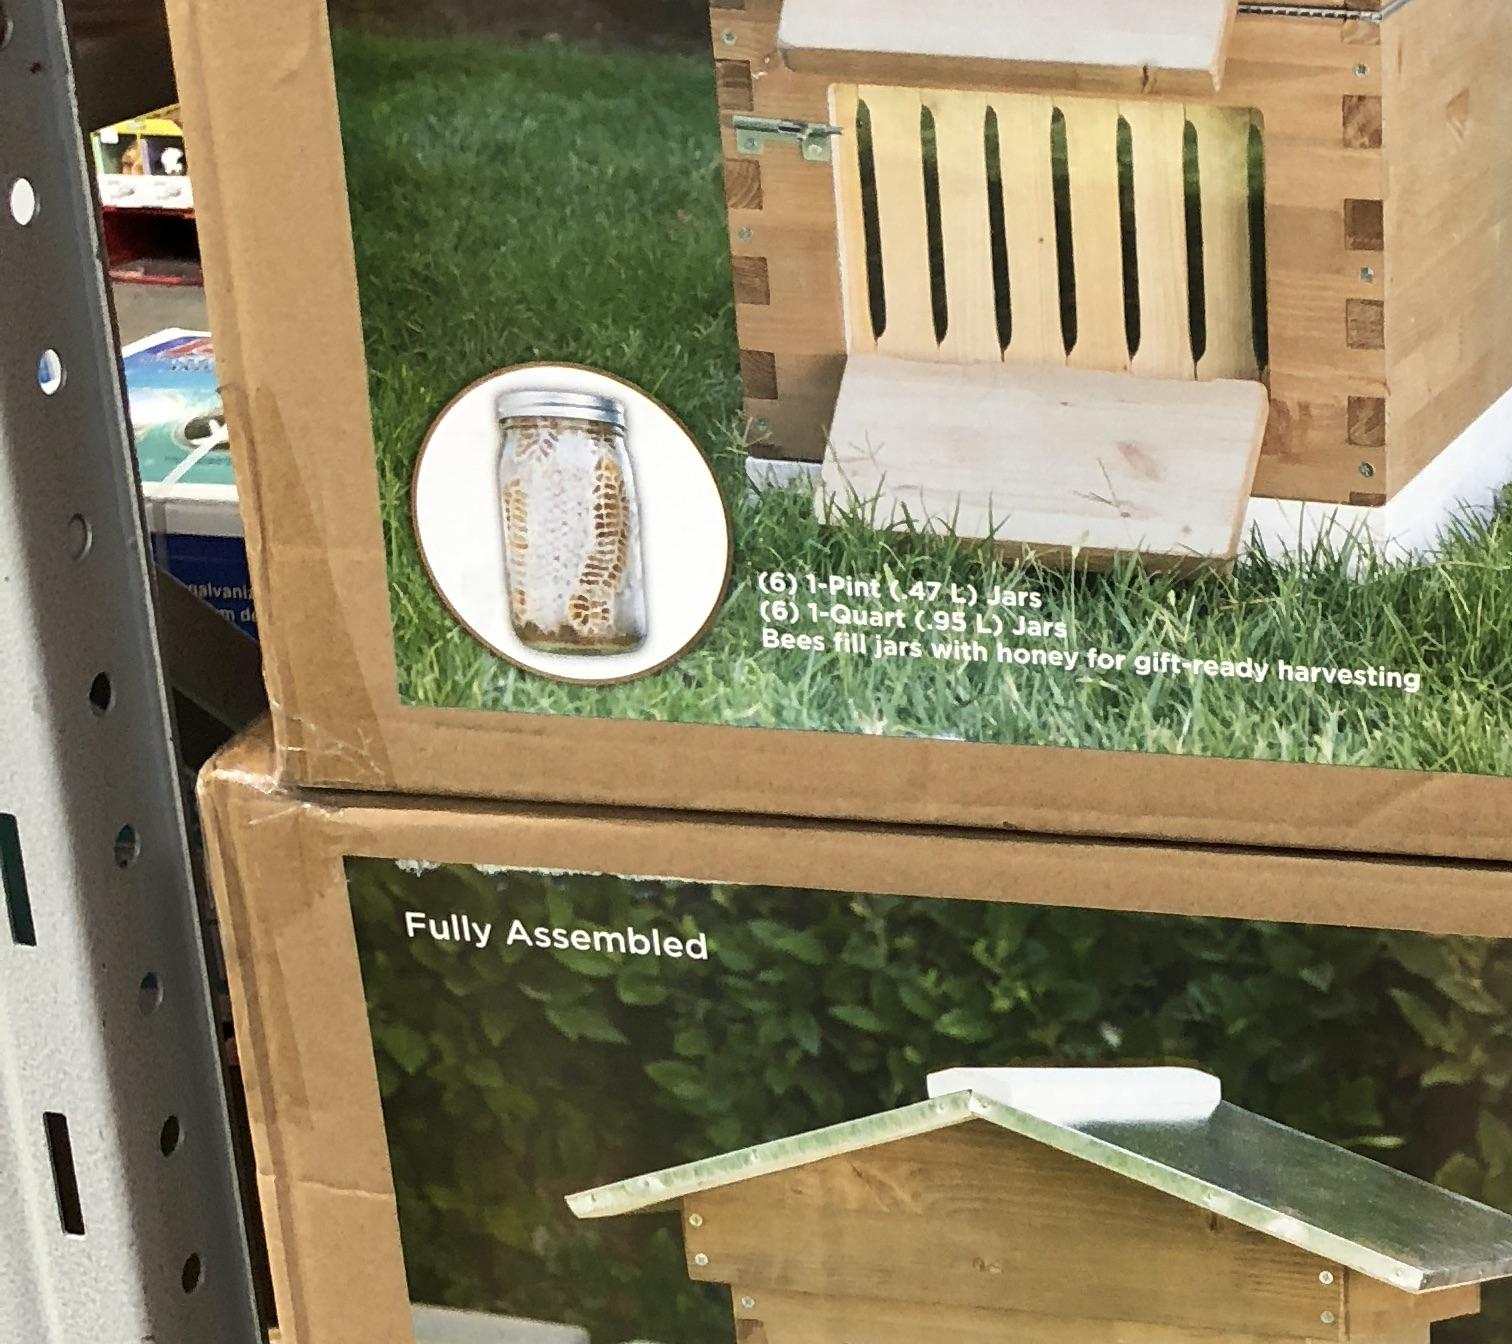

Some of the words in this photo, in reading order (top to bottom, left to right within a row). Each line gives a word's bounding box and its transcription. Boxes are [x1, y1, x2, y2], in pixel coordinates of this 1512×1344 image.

[758, 571, 798, 596] (6)
[806, 573, 881, 599] 1-Pint
[889, 579, 942, 603] (.47
[951, 584, 978, 607] L)
[987, 583, 1042, 609] Jars
[760, 599, 799, 624] (6)
[807, 602, 906, 629] 1-Quart
[914, 609, 967, 633] (.95
[976, 612, 1003, 637] L)
[1012, 615, 1068, 639] Jars
[762, 627, 825, 651] Bees
[833, 631, 866, 655] fill
[873, 634, 922, 659] jars
[931, 637, 988, 662] with
[997, 641, 1079, 671] honey
[1087, 647, 1126, 670] for
[1133, 651, 1269, 683] gift-ready
[1278, 658, 1421, 694] harvesting
[405, 911, 492, 947] Fully
[507, 918, 708, 960] Assembled
